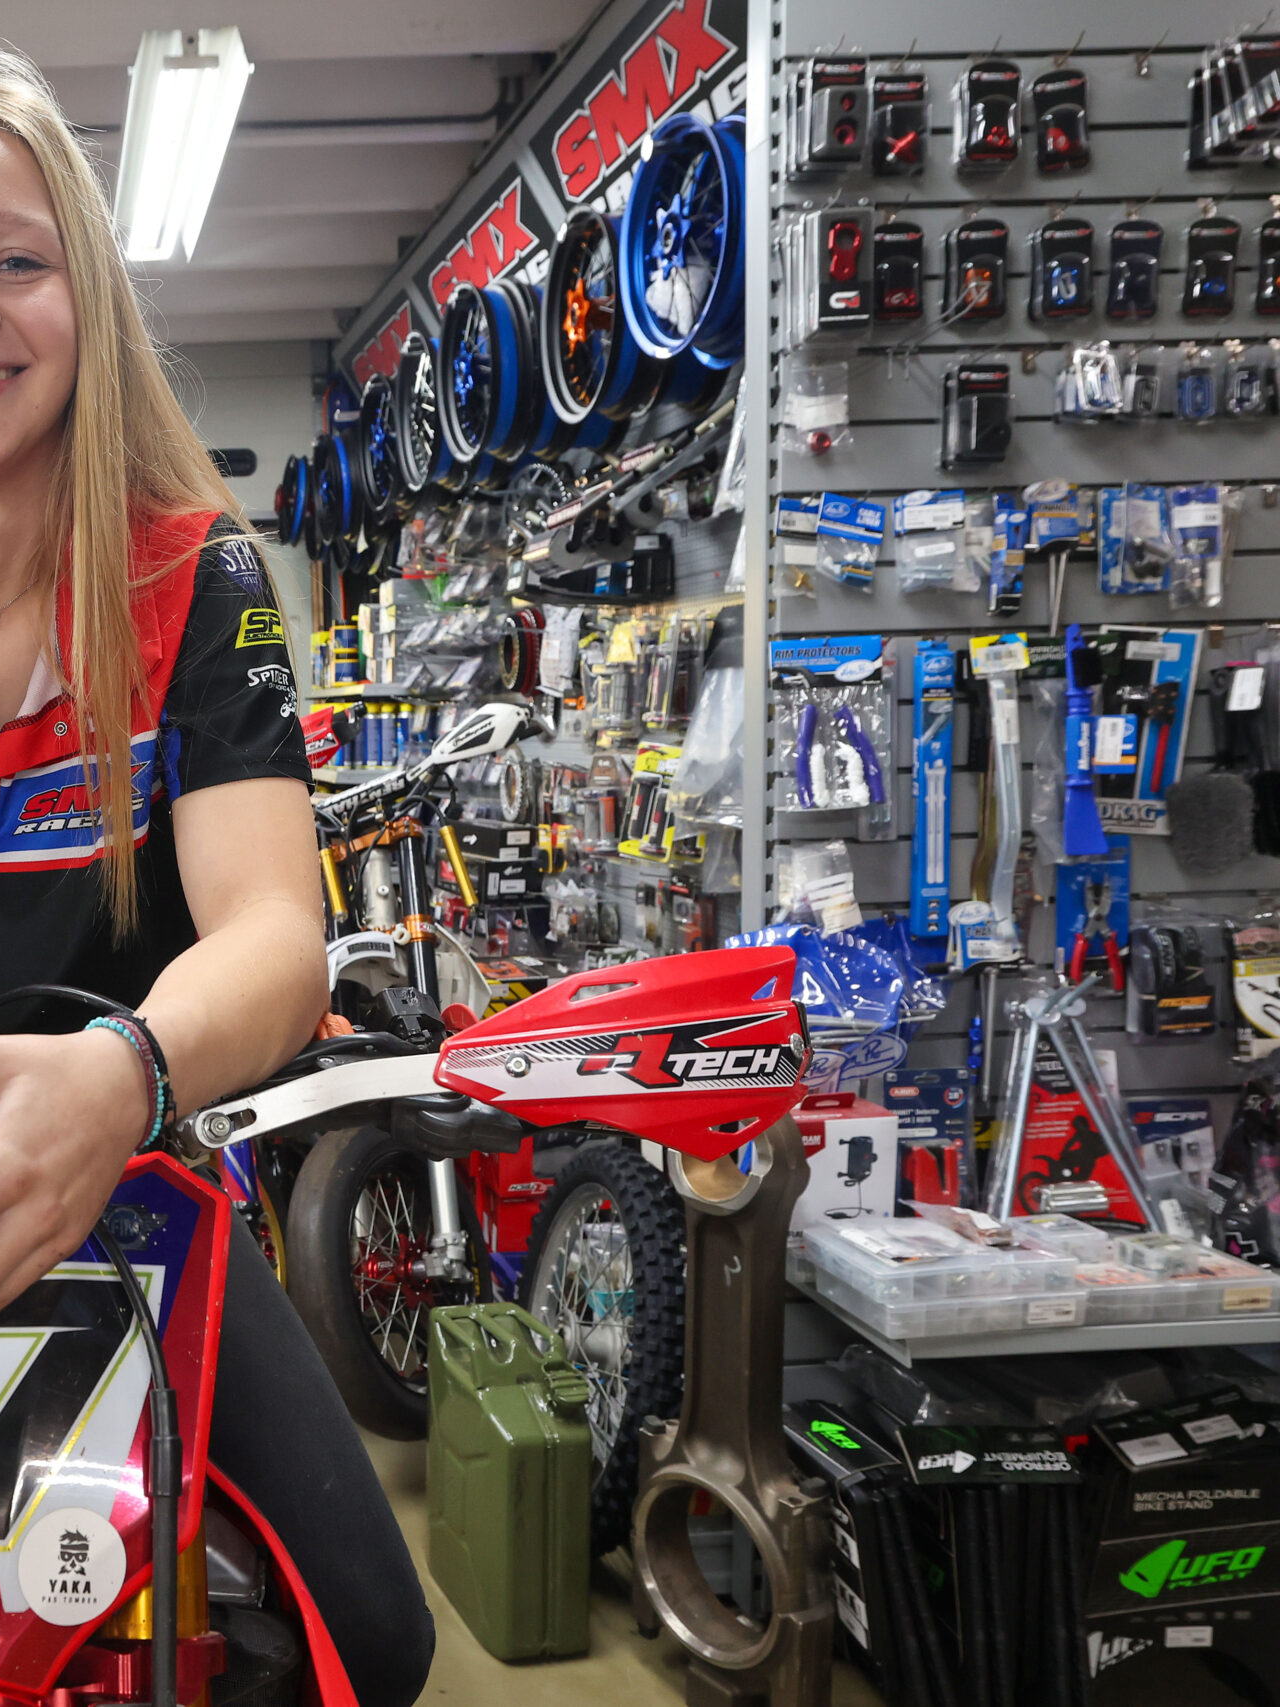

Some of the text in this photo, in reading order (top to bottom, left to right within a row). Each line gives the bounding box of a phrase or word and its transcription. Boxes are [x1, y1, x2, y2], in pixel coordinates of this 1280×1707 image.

[552, 0, 738, 203] SMX
[428, 176, 540, 318] SMX
[244, 611, 282, 635] SP
[774, 645, 861, 660] RIM PROTECTORS
[1002, 1461, 1071, 1471] OFFROAD
[1134, 1488, 1260, 1501] MECHA FOLDABLE
[1133, 1500, 1213, 1511] BIKE STAND
[1170, 1546, 1266, 1580] UFO
[49, 1579, 91, 1594] YAKA
